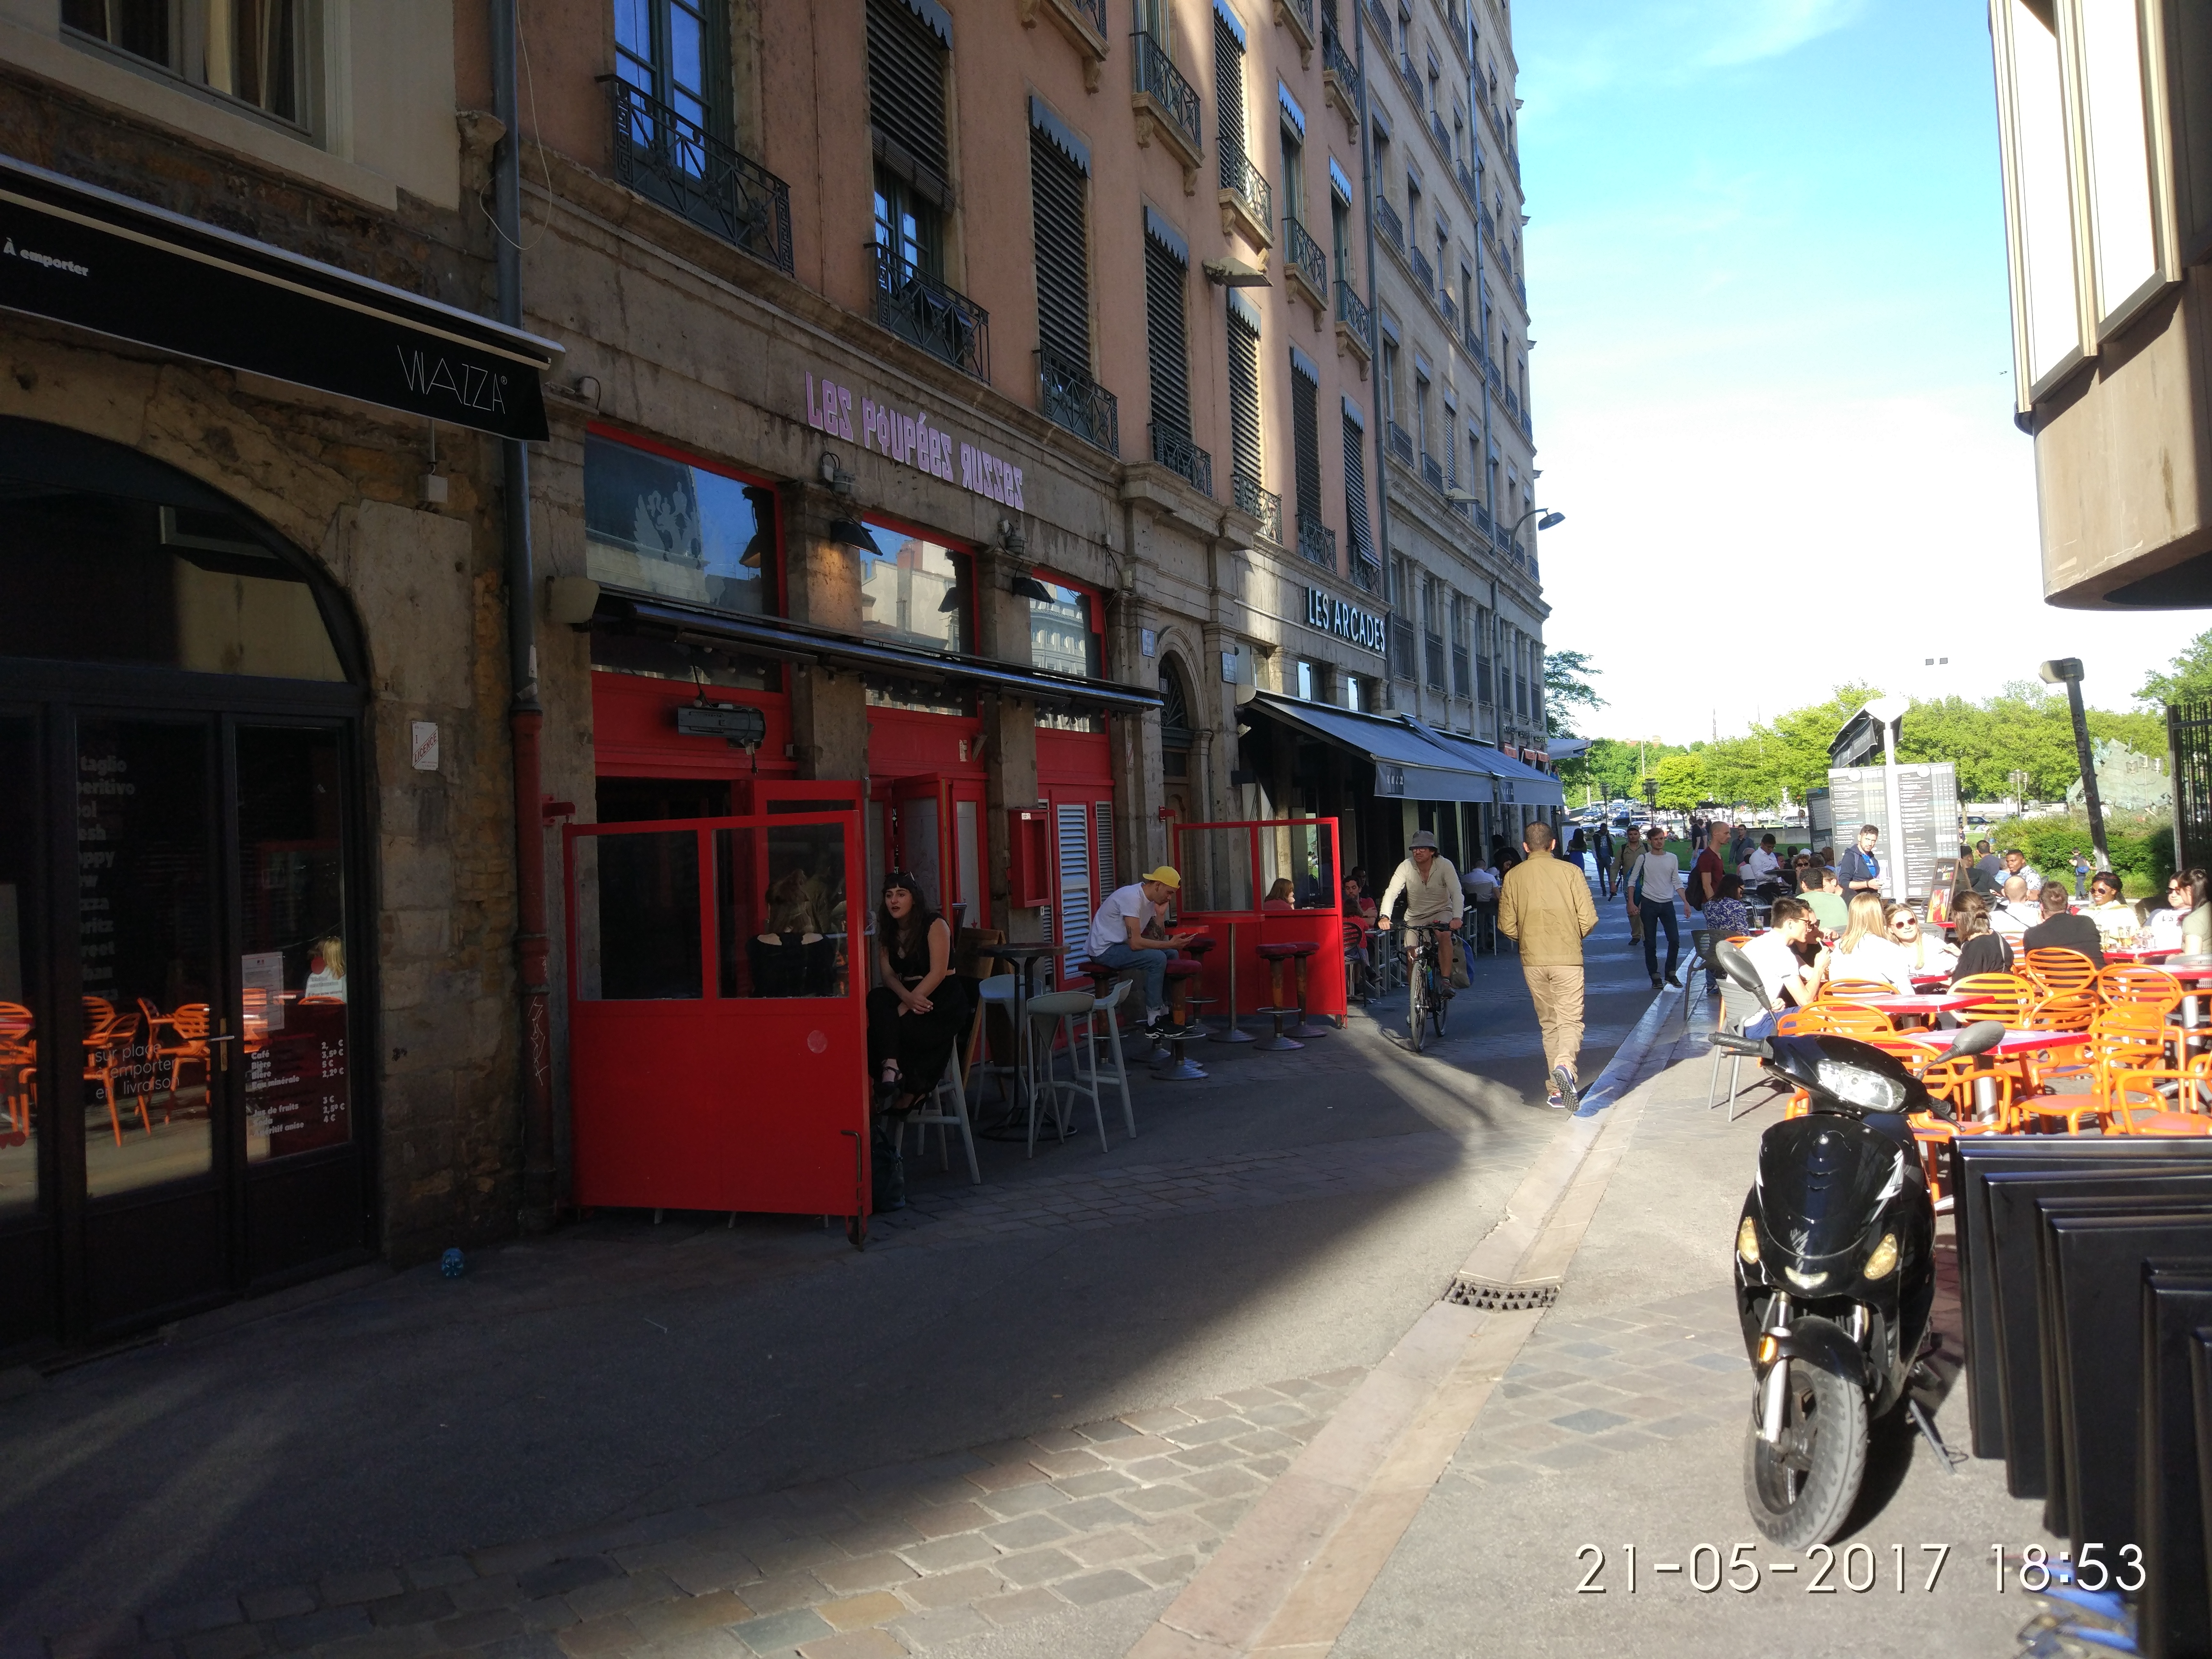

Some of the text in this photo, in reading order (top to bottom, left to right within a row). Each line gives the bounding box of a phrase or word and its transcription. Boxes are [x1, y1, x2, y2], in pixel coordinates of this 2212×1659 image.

[3, 238, 89, 277] À emporter
[1307, 587, 1385, 653] LES ARCADES
[414, 733, 437, 763] LICENCE
[80, 755, 127, 776] taglio
[95, 1044, 162, 1062] sur place
[251, 1049, 270, 1060] Café
[338, 1039, 344, 1047] €
[251, 1048, 344, 1070] Bière 3,50 €
[110, 1058, 176, 1079] emporter
[322, 1060, 327, 1069] 5
[96, 1076, 180, 1099] en livraison
[252, 1067, 344, 1090] Eau minérale 2,20 €
[252, 1095, 335, 1118] Jus de fruits 3 €
[253, 1103, 346, 1127] Soda 2,50 €
[323, 1115, 329, 1123] 4
[330, 1114, 336, 1122] €
